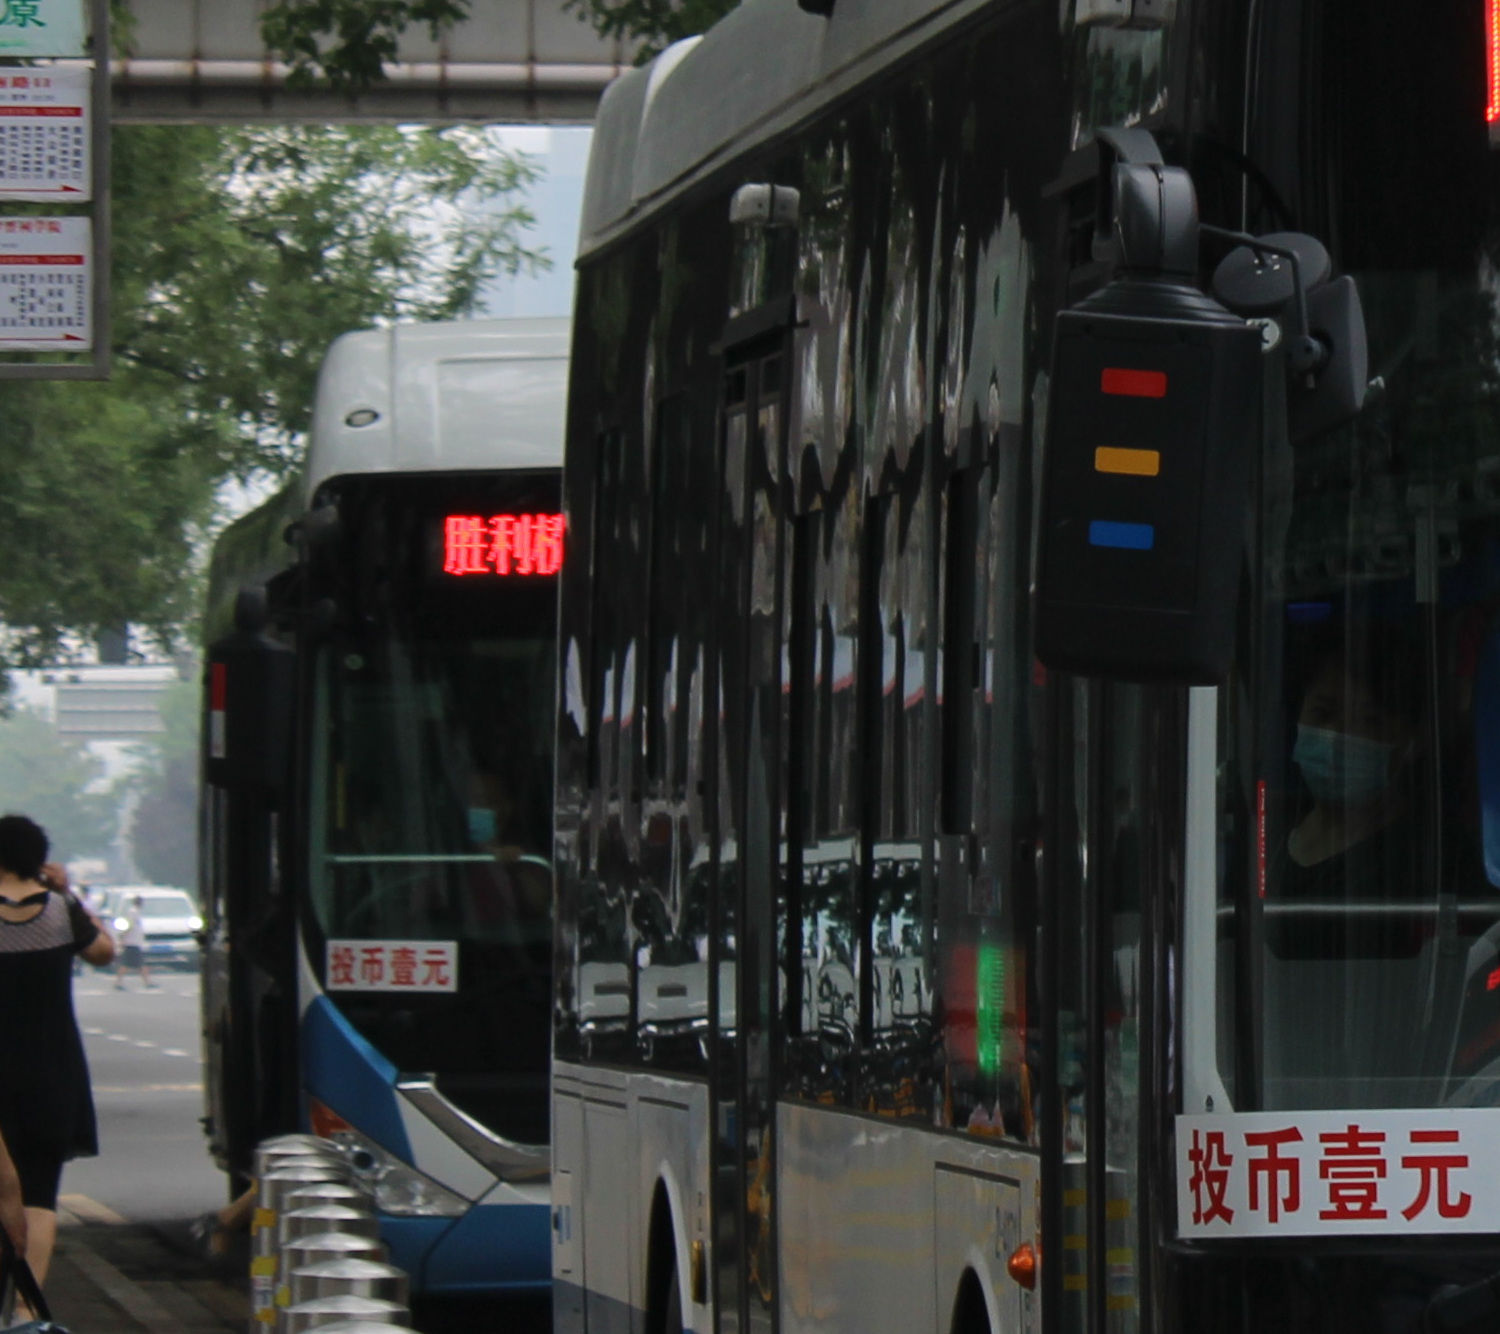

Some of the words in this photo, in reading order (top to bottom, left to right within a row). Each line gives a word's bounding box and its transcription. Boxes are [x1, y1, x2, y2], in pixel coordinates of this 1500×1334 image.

[329, 944, 452, 990] 投币壹元
[1187, 1124, 1472, 1227] 投币壹元
